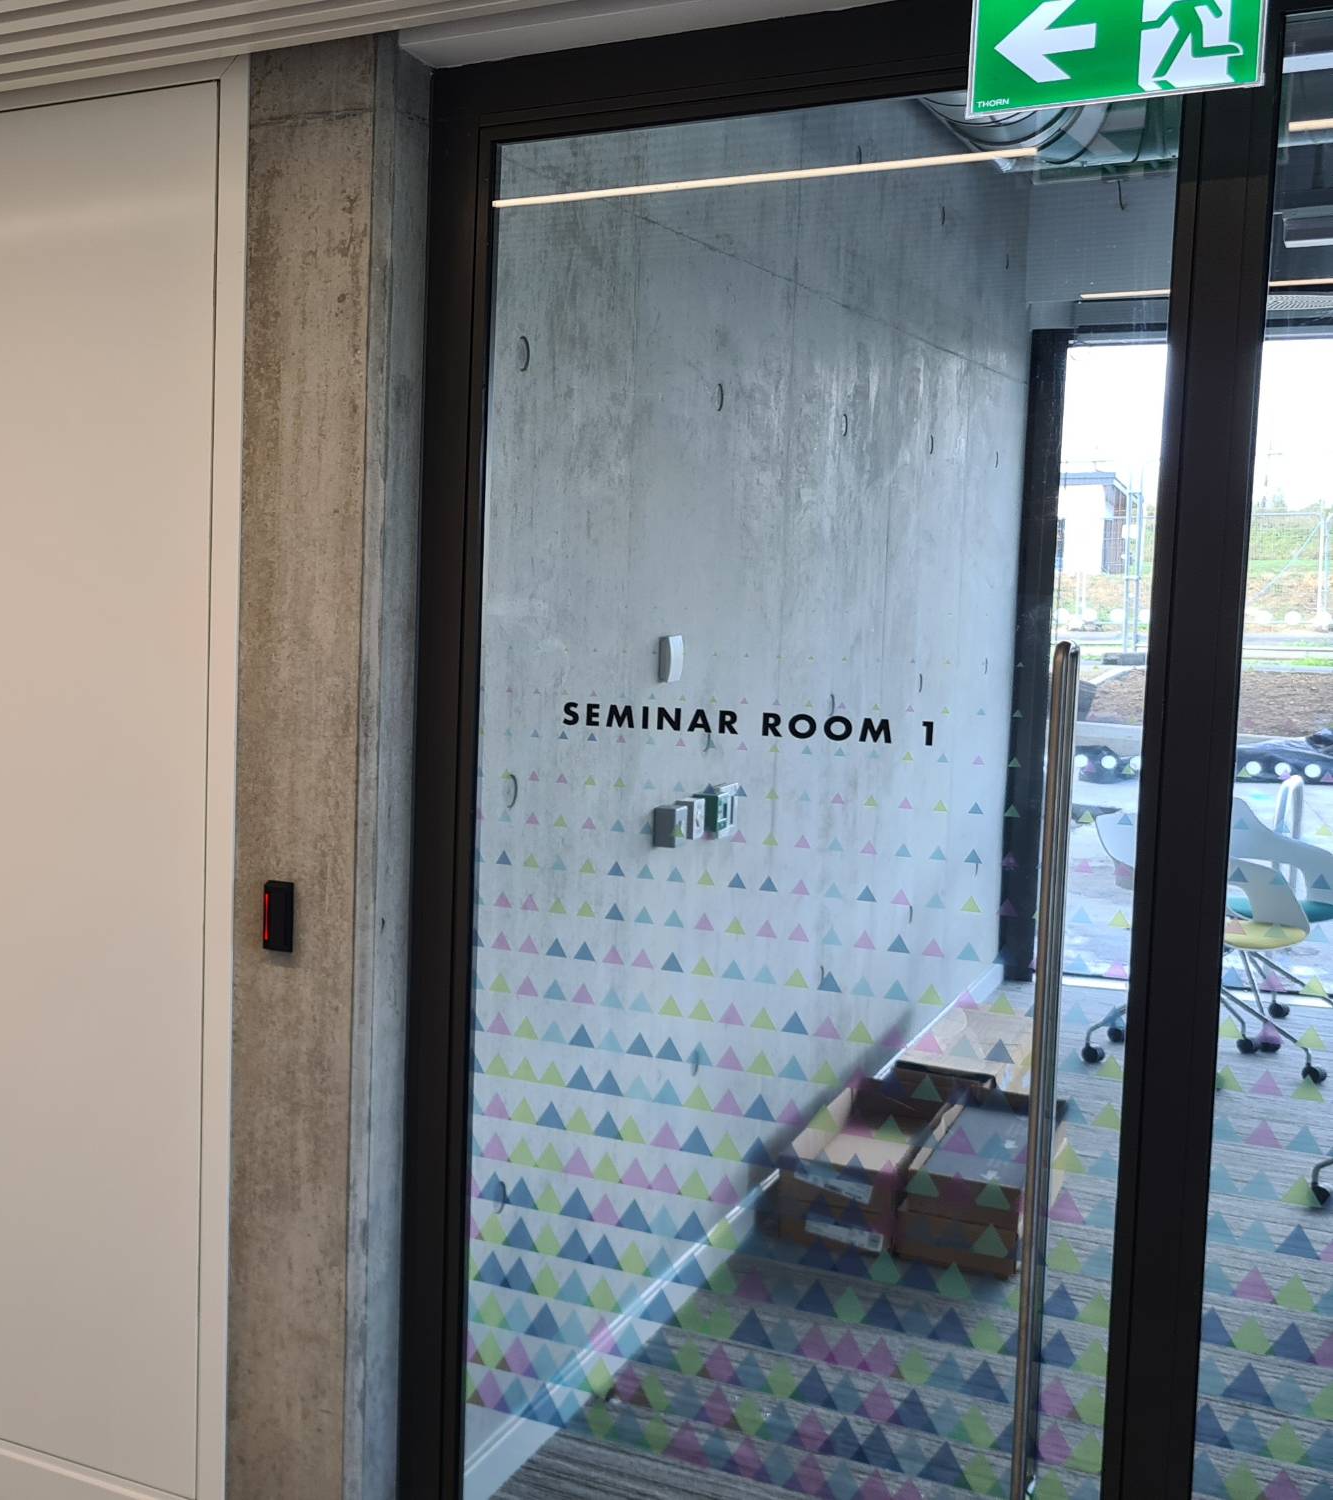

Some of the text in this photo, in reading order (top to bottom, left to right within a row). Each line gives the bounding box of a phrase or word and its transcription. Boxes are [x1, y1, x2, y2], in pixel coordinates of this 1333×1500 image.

[977, 98, 1010, 108] THORN
[563, 702, 935, 746] SEMINAR ROOM 1
